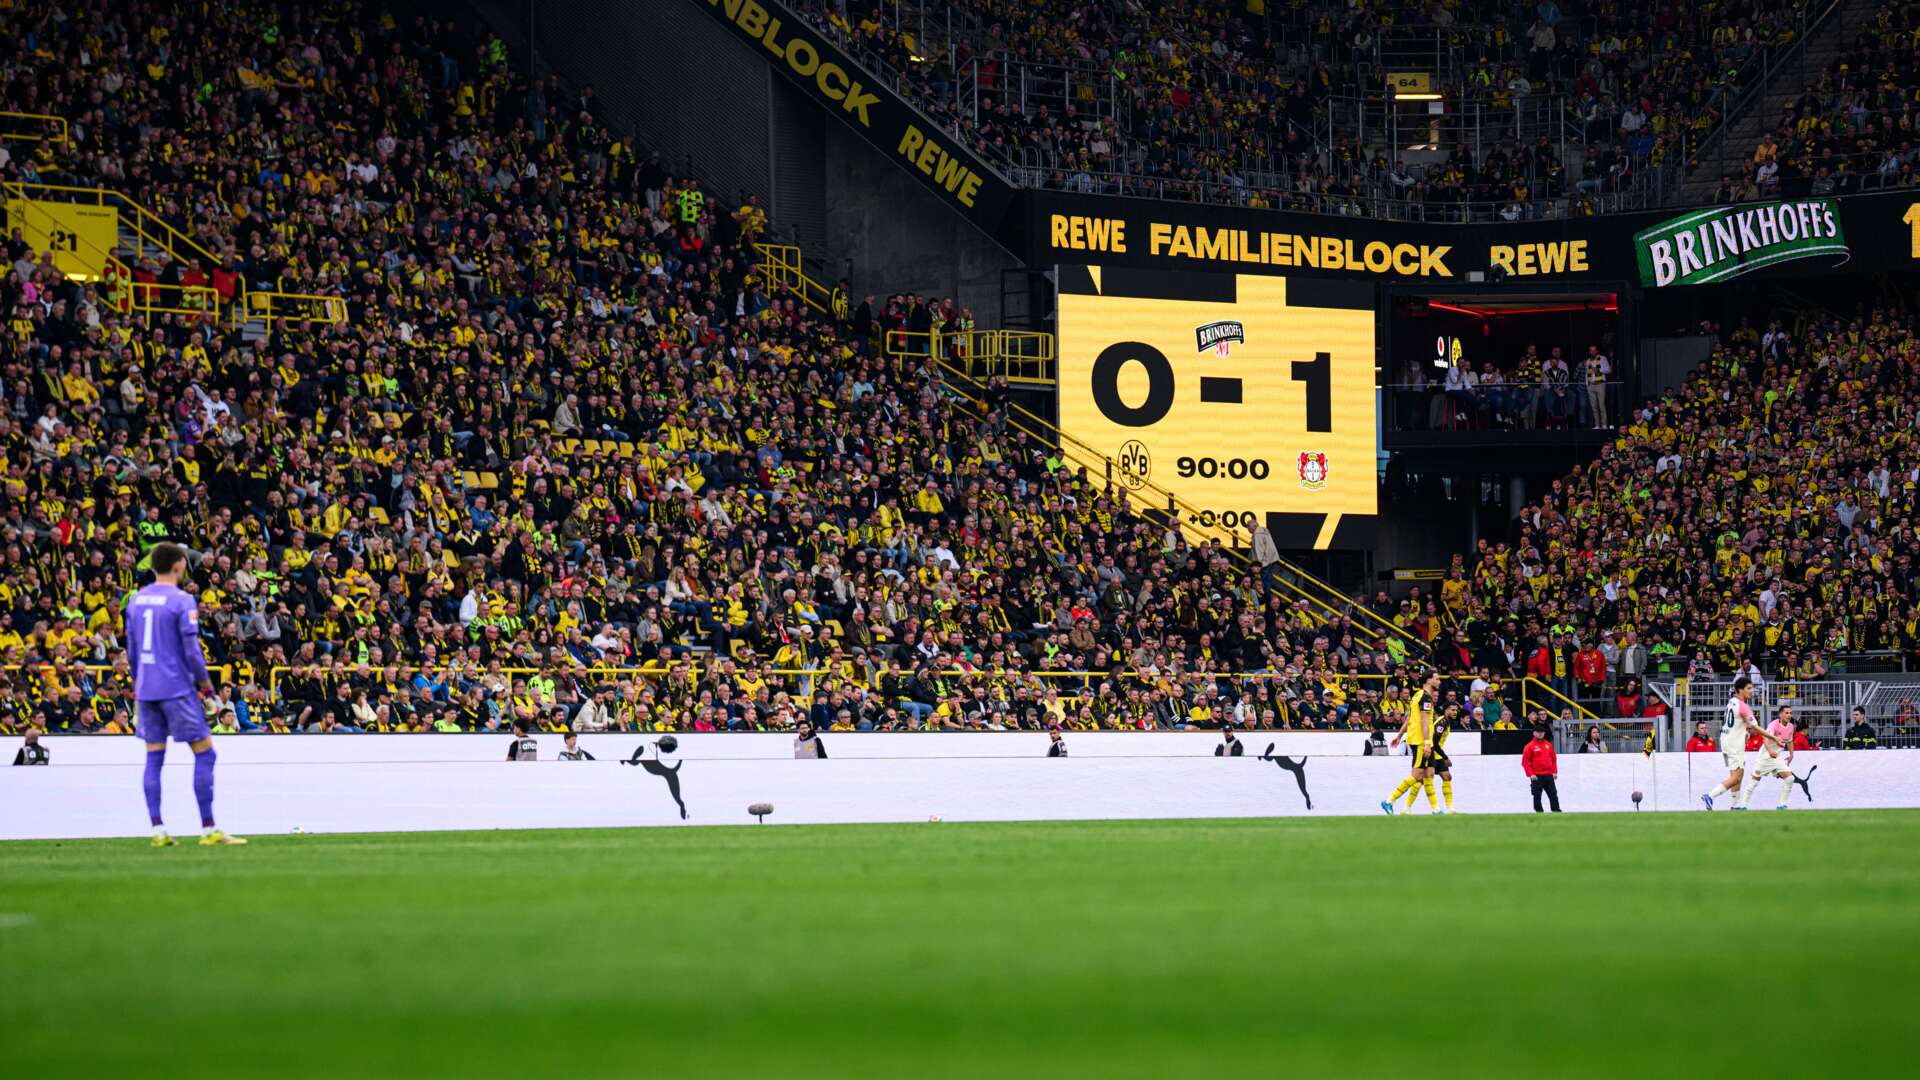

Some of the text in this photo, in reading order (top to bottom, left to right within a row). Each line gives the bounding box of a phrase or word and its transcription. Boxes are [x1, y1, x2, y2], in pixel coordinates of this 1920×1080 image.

[1399, 79, 1418, 88] 64
[898, 125, 983, 208] REWE
[50, 230, 77, 252] 21
[1051, 214, 1589, 278] REWE FAMILIENBLOCK REWE
[1092, 341, 1175, 428] 0
[1291, 352, 1332, 433] 1
[1176, 456, 1270, 480] 90:00
[143, 608, 153, 651] 1
